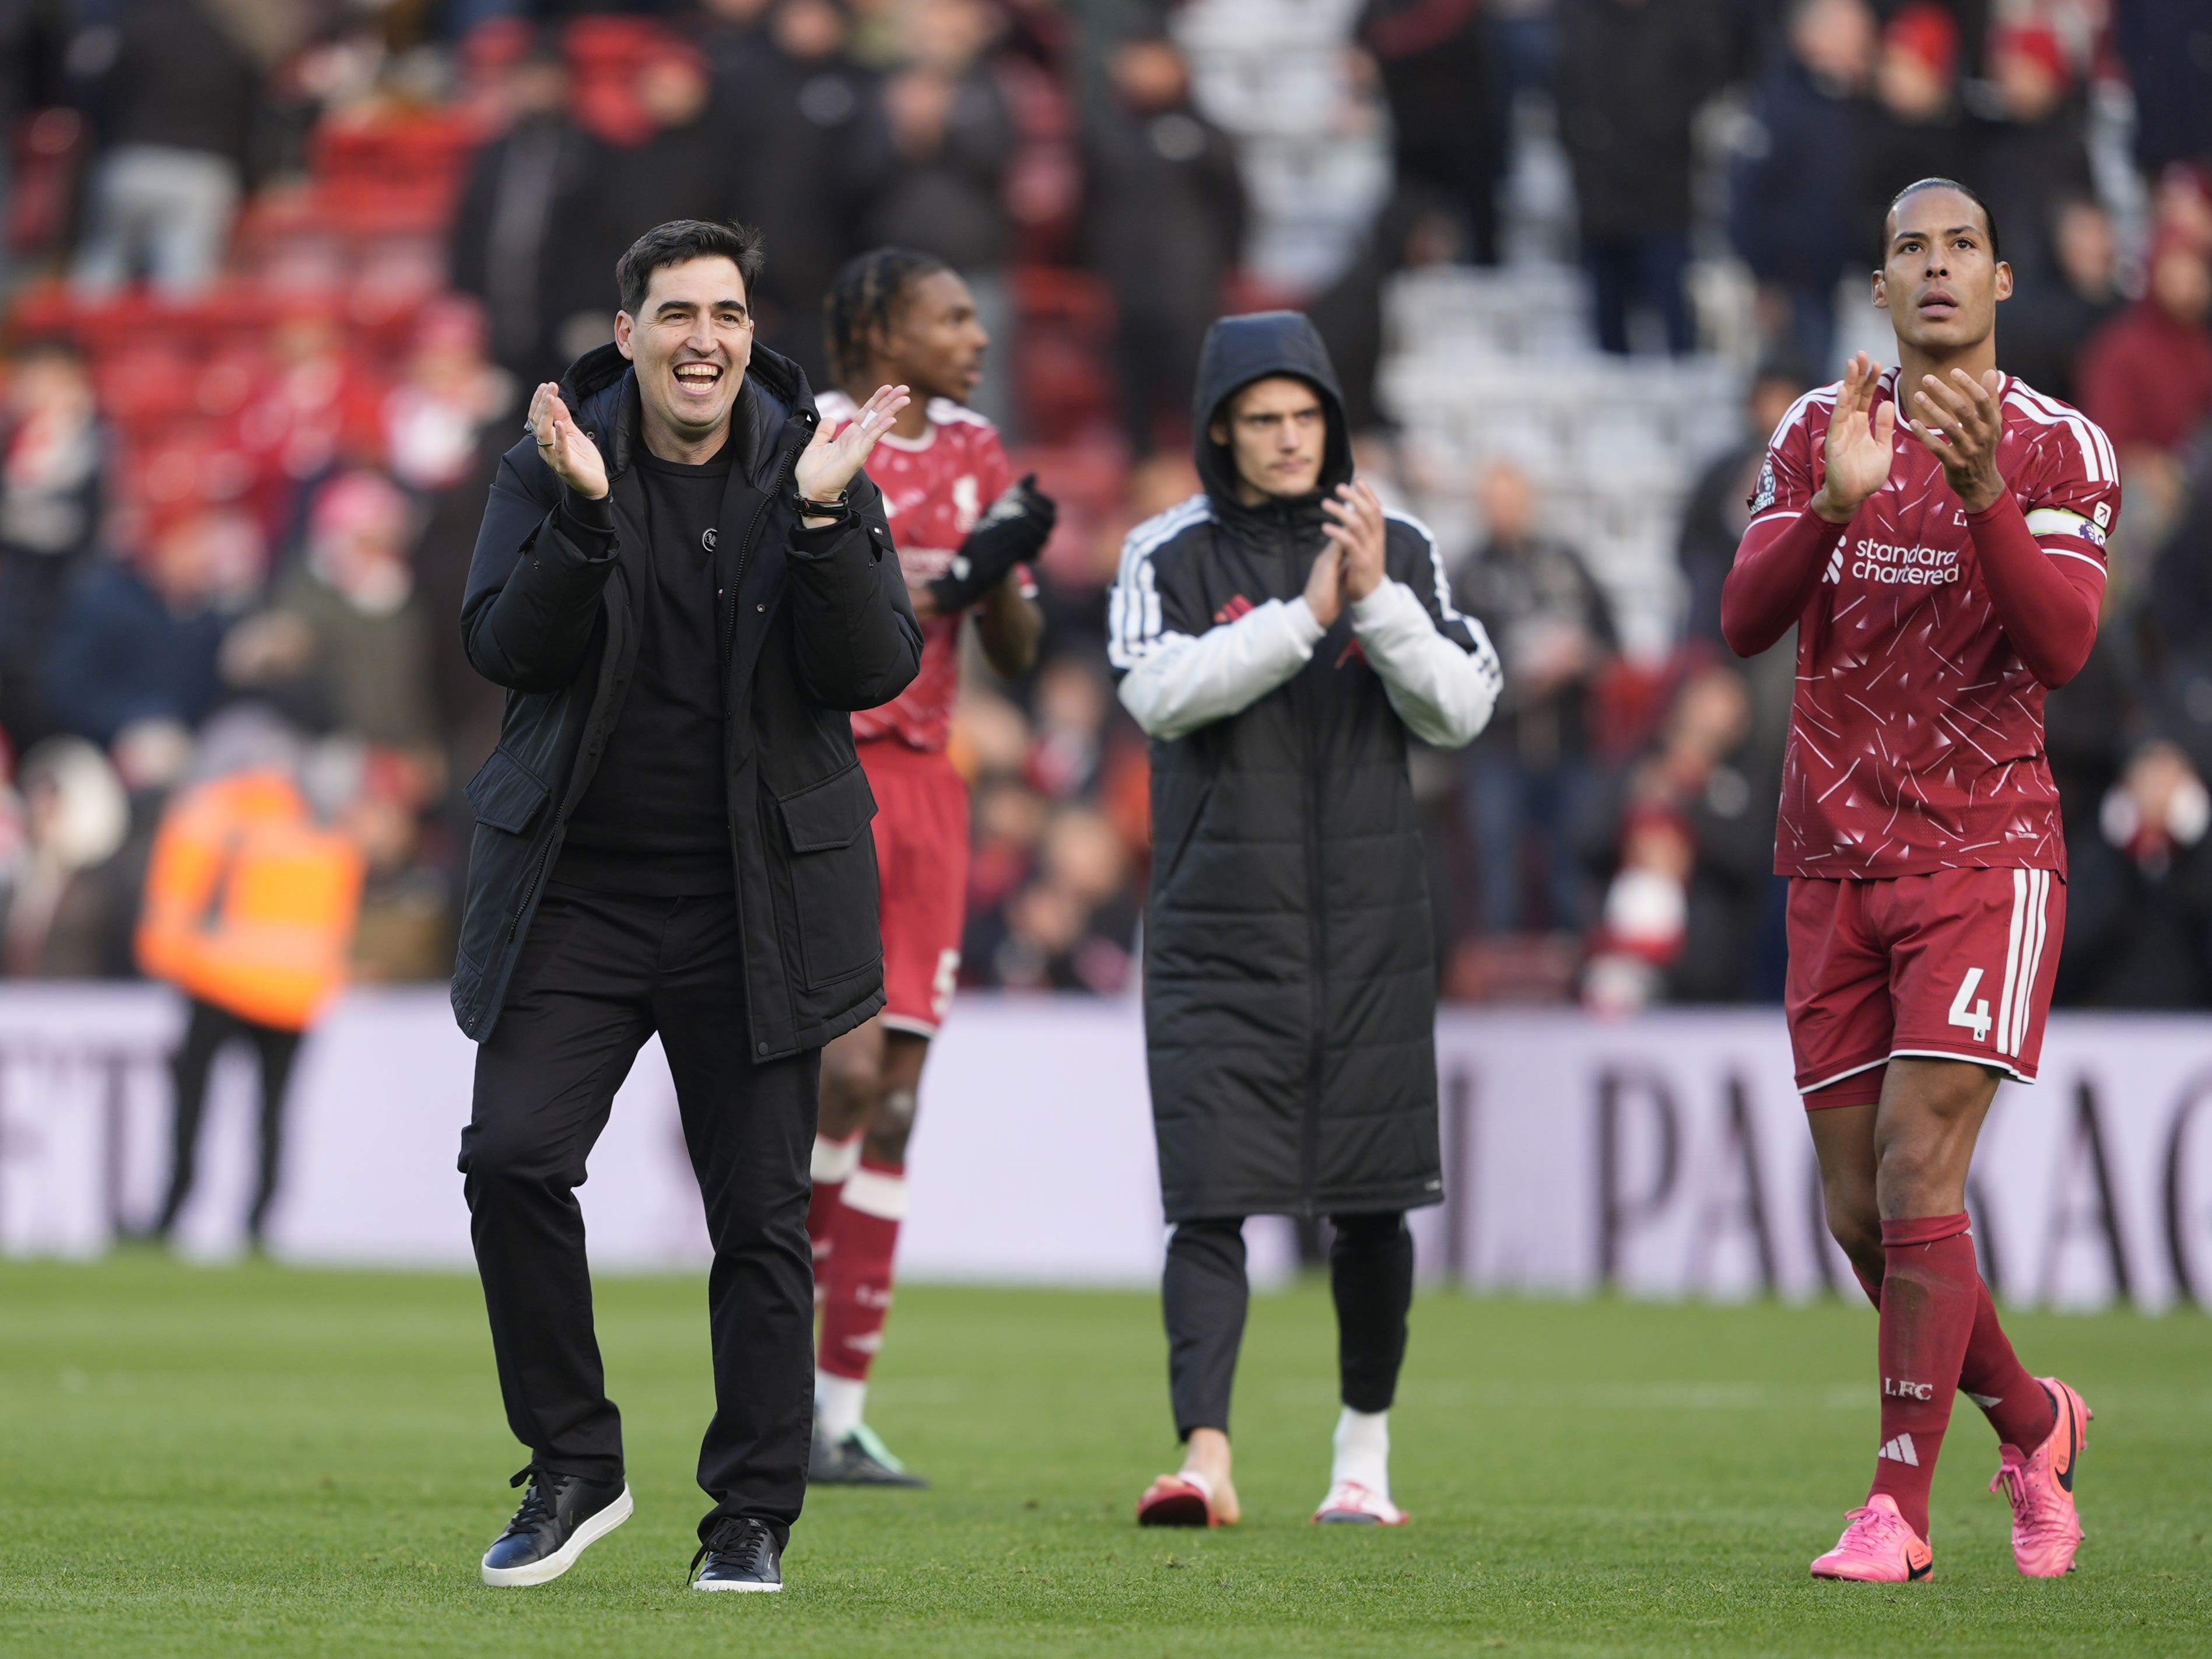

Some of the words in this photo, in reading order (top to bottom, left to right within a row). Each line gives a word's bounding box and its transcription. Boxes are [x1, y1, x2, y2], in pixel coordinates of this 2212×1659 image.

[1856, 538, 1959, 566] standard
[1852, 559, 1959, 585] chartered
[1948, 967, 1992, 1042] 4
[1885, 1377, 1933, 1400] LFC
